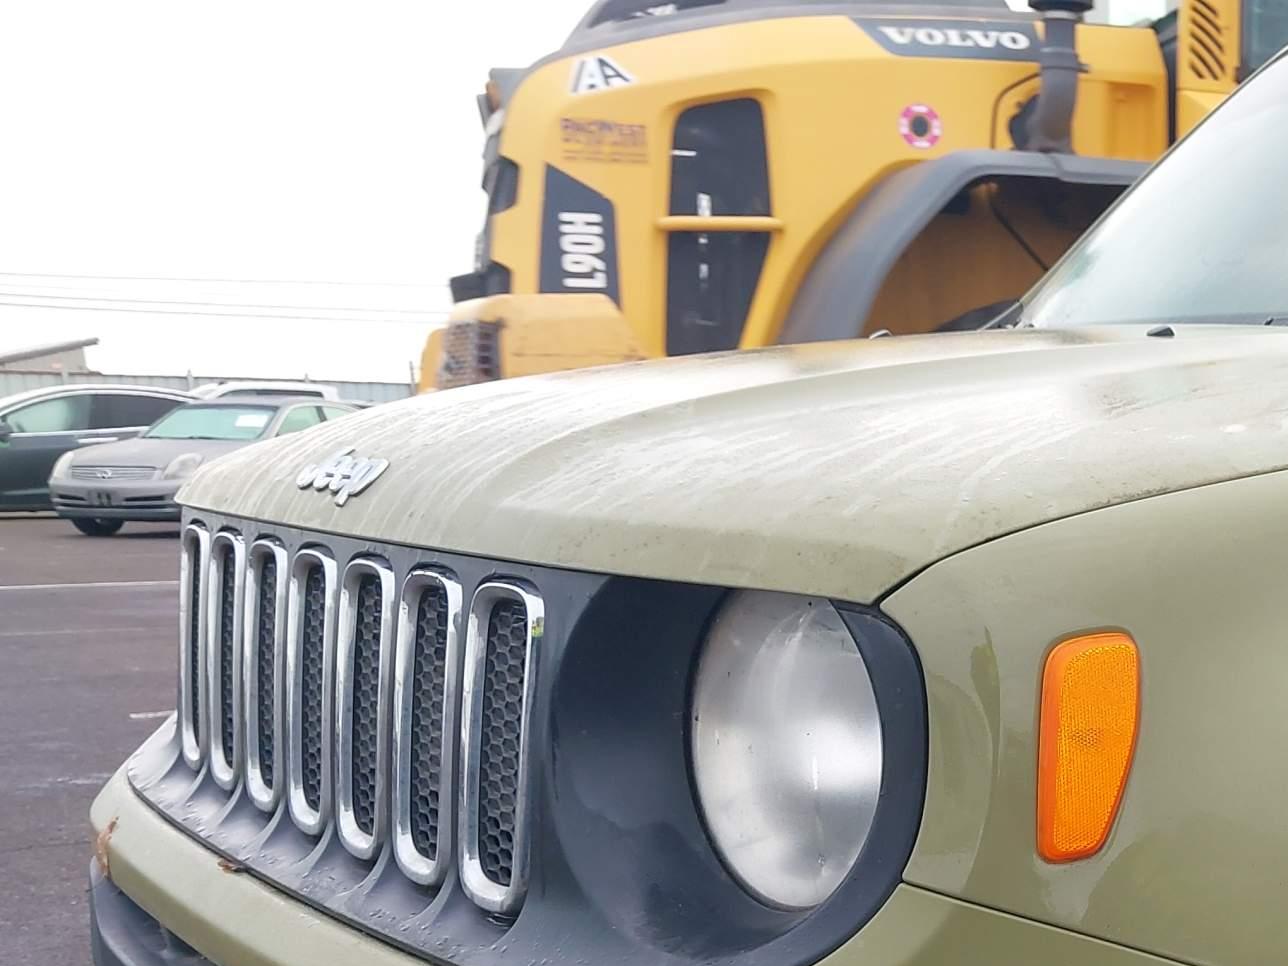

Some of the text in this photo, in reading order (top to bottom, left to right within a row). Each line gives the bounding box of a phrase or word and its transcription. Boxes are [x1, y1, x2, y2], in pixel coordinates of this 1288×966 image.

[878, 26, 1031, 50] VOLVO
[558, 211, 608, 289] L90H
[296, 449, 388, 507] Jeep
